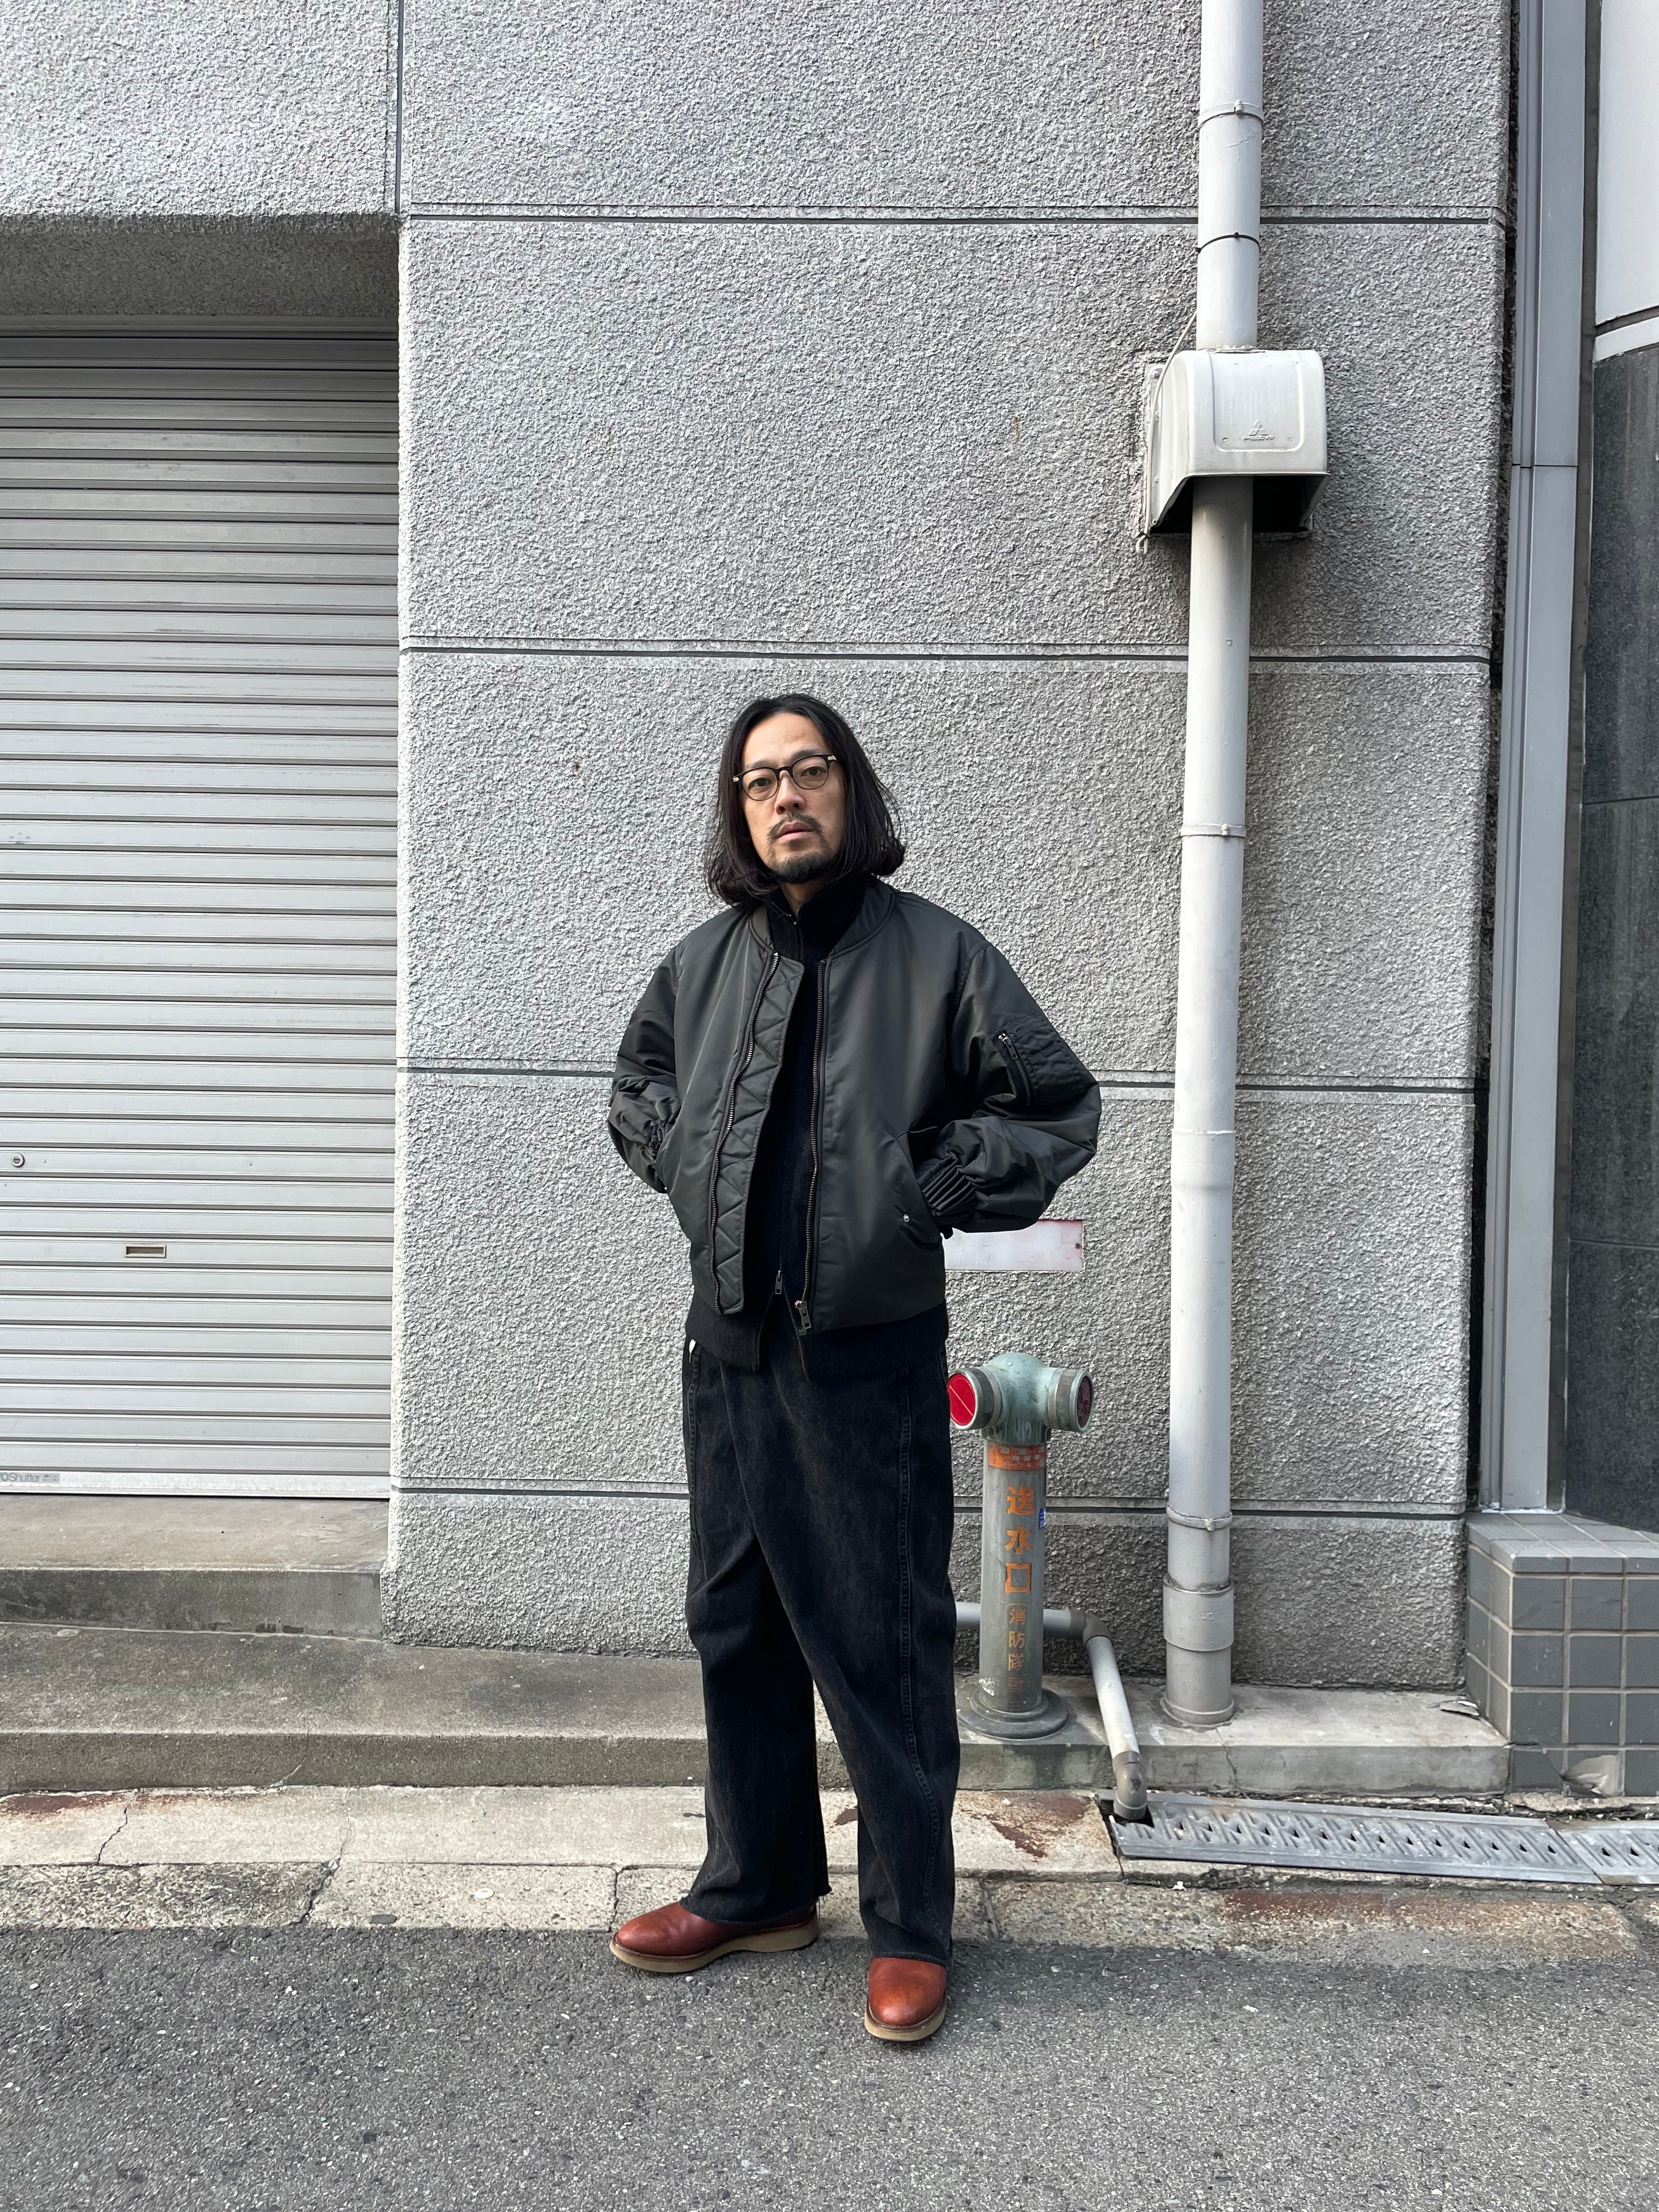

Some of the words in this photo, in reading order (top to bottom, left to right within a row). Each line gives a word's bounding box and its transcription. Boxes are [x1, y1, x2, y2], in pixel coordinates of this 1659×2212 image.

[9, 1472, 41, 1482] Shutter
[1005, 1485, 1035, 1594] 送水口
